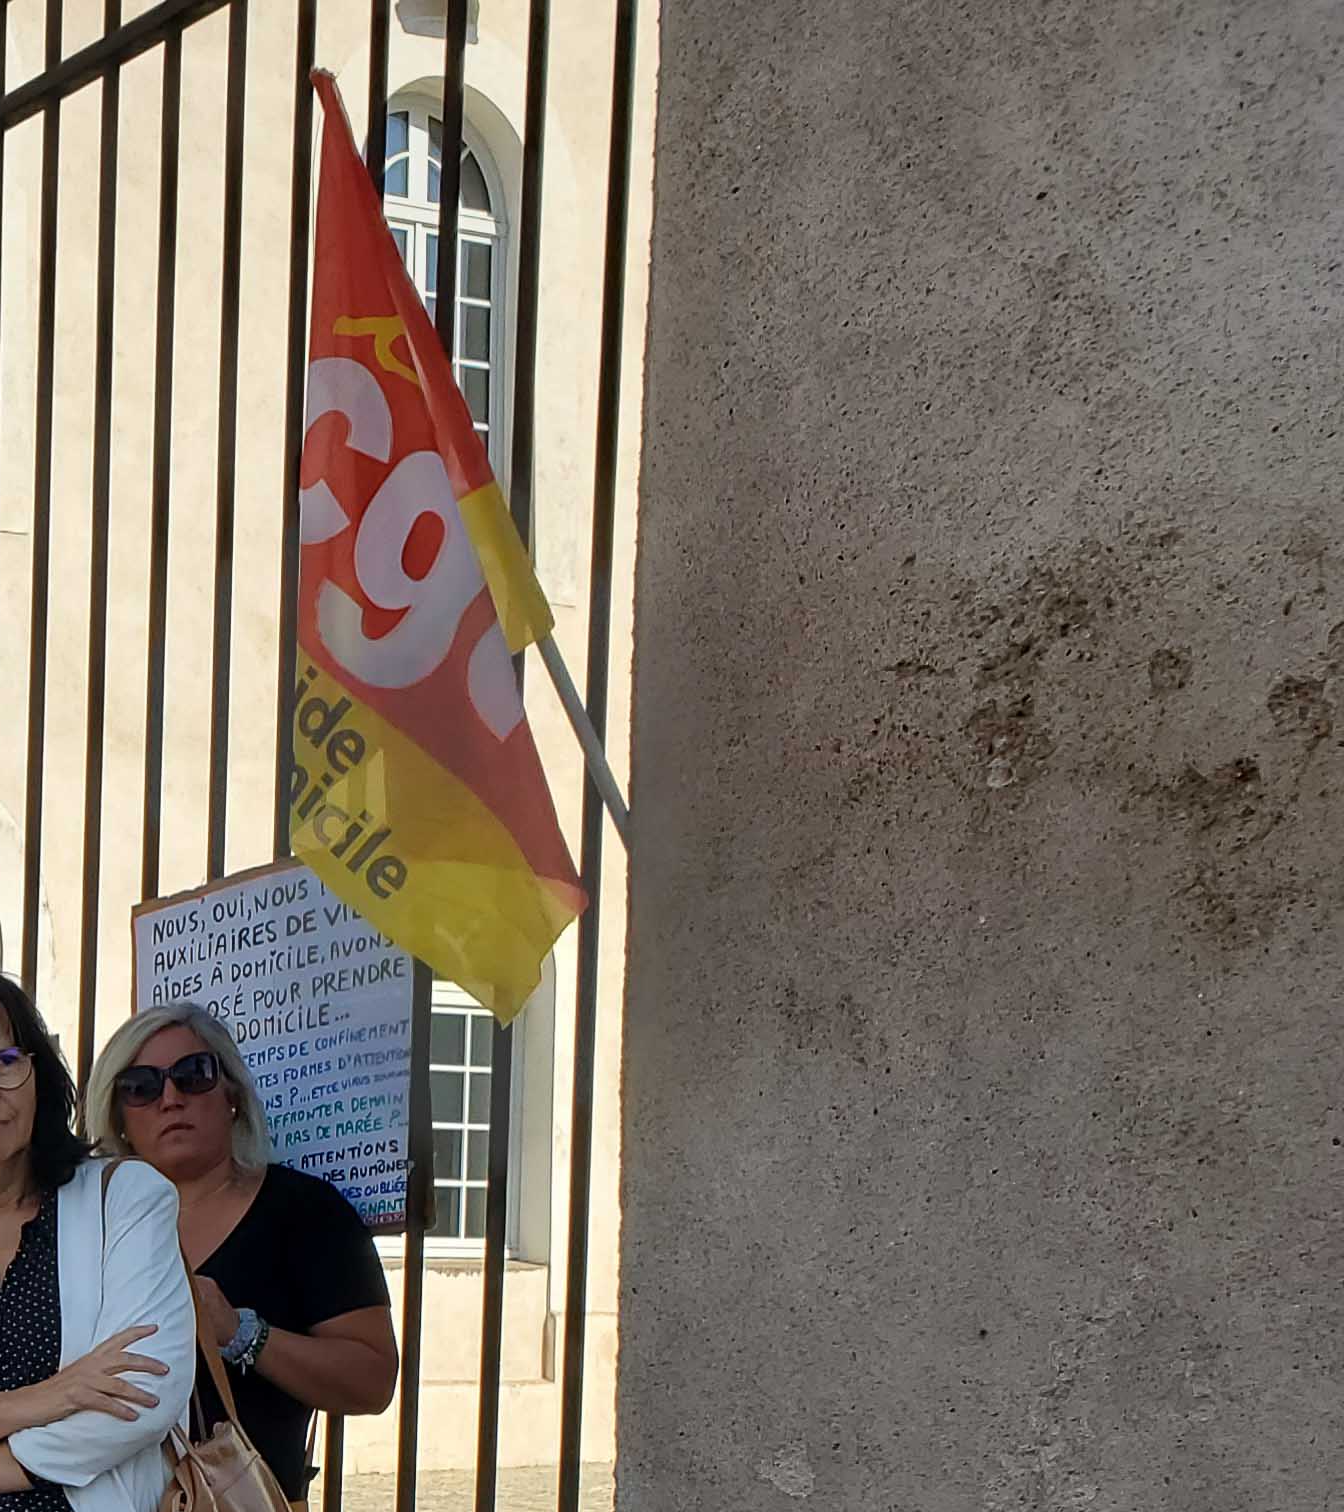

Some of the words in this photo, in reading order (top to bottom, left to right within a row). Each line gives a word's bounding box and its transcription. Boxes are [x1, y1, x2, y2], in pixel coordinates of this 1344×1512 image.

[296, 665, 365, 775] ide
[285, 908, 318, 937] DE
[253, 981, 303, 1013] POUR
[312, 955, 407, 999] PRENDRE
[288, 1040, 310, 1059] DE
[255, 1072, 279, 1089] TES
[283, 1060, 332, 1084] FORMES
[263, 1093, 283, 1111] NS
[335, 1112, 384, 1138] MARÉE
[358, 1198, 405, 1217] GNANT
